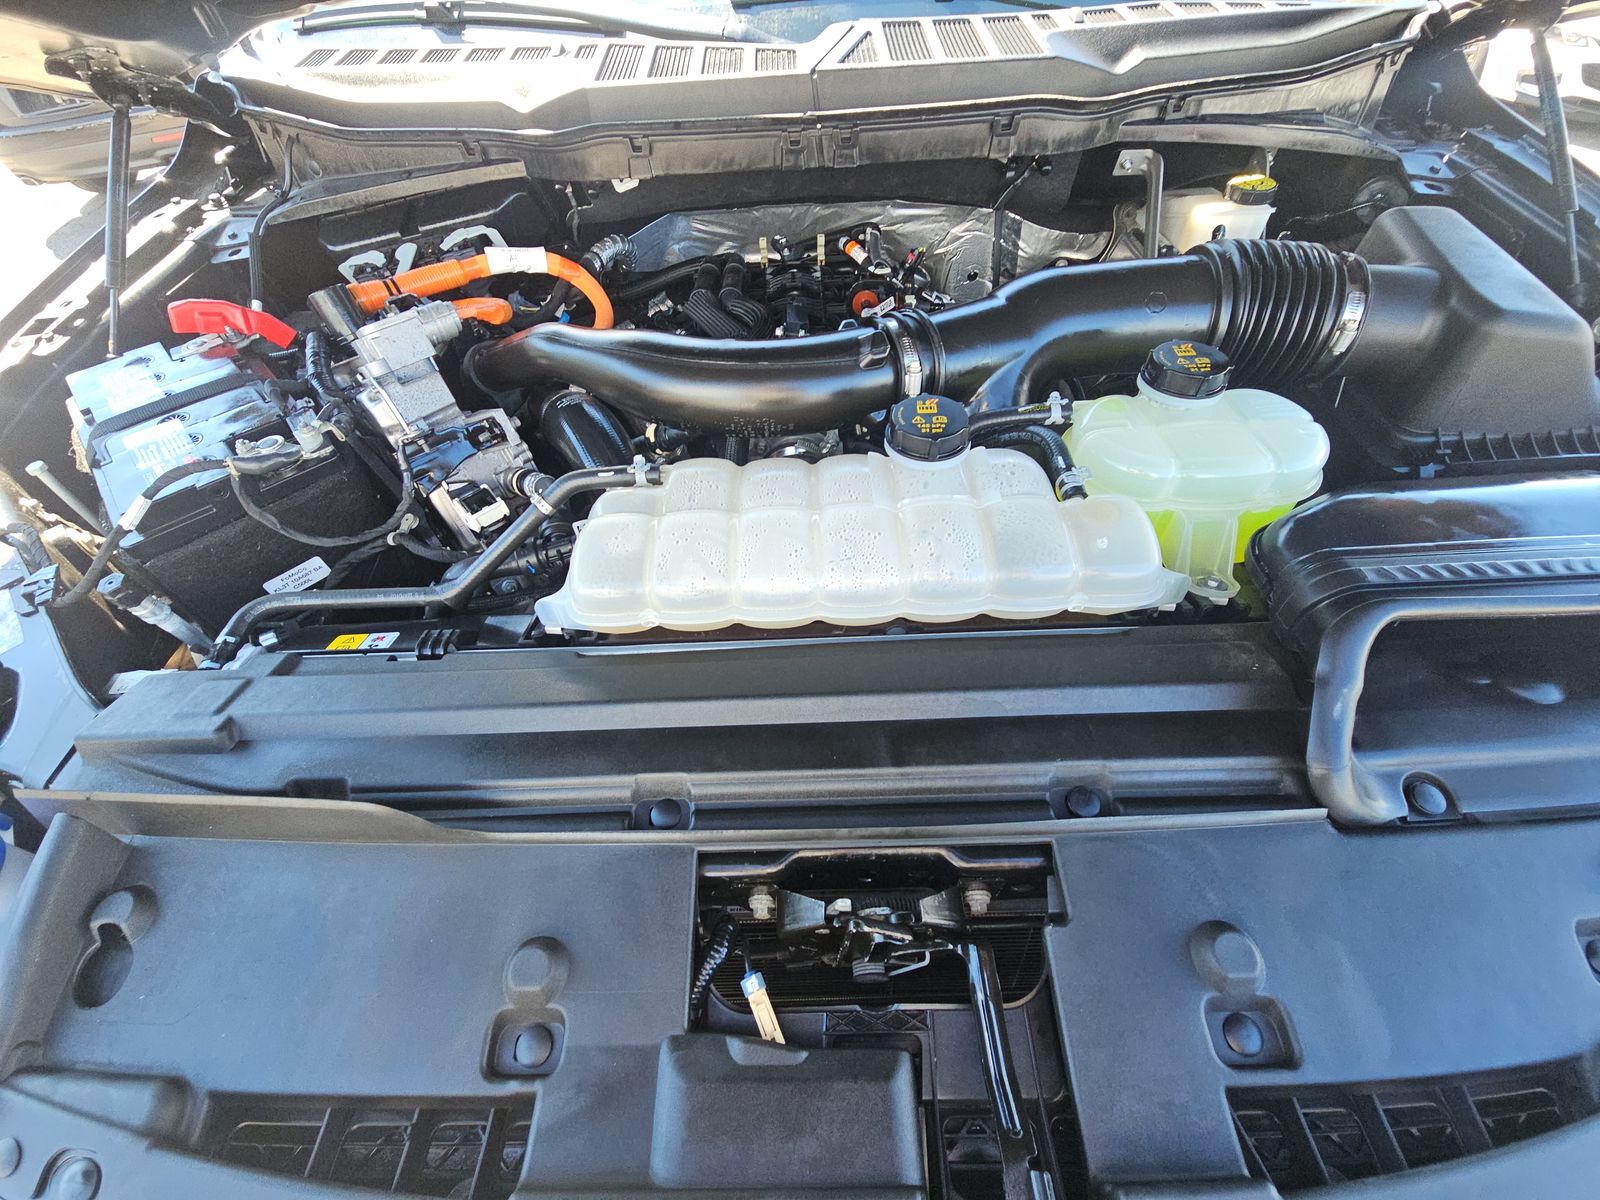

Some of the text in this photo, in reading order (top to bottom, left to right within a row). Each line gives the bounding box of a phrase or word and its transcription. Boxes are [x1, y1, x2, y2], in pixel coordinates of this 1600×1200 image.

[274, 582, 290, 592] KL3T
[313, 565, 323, 573] BA
[281, 567, 307, 582] FoMoCo
